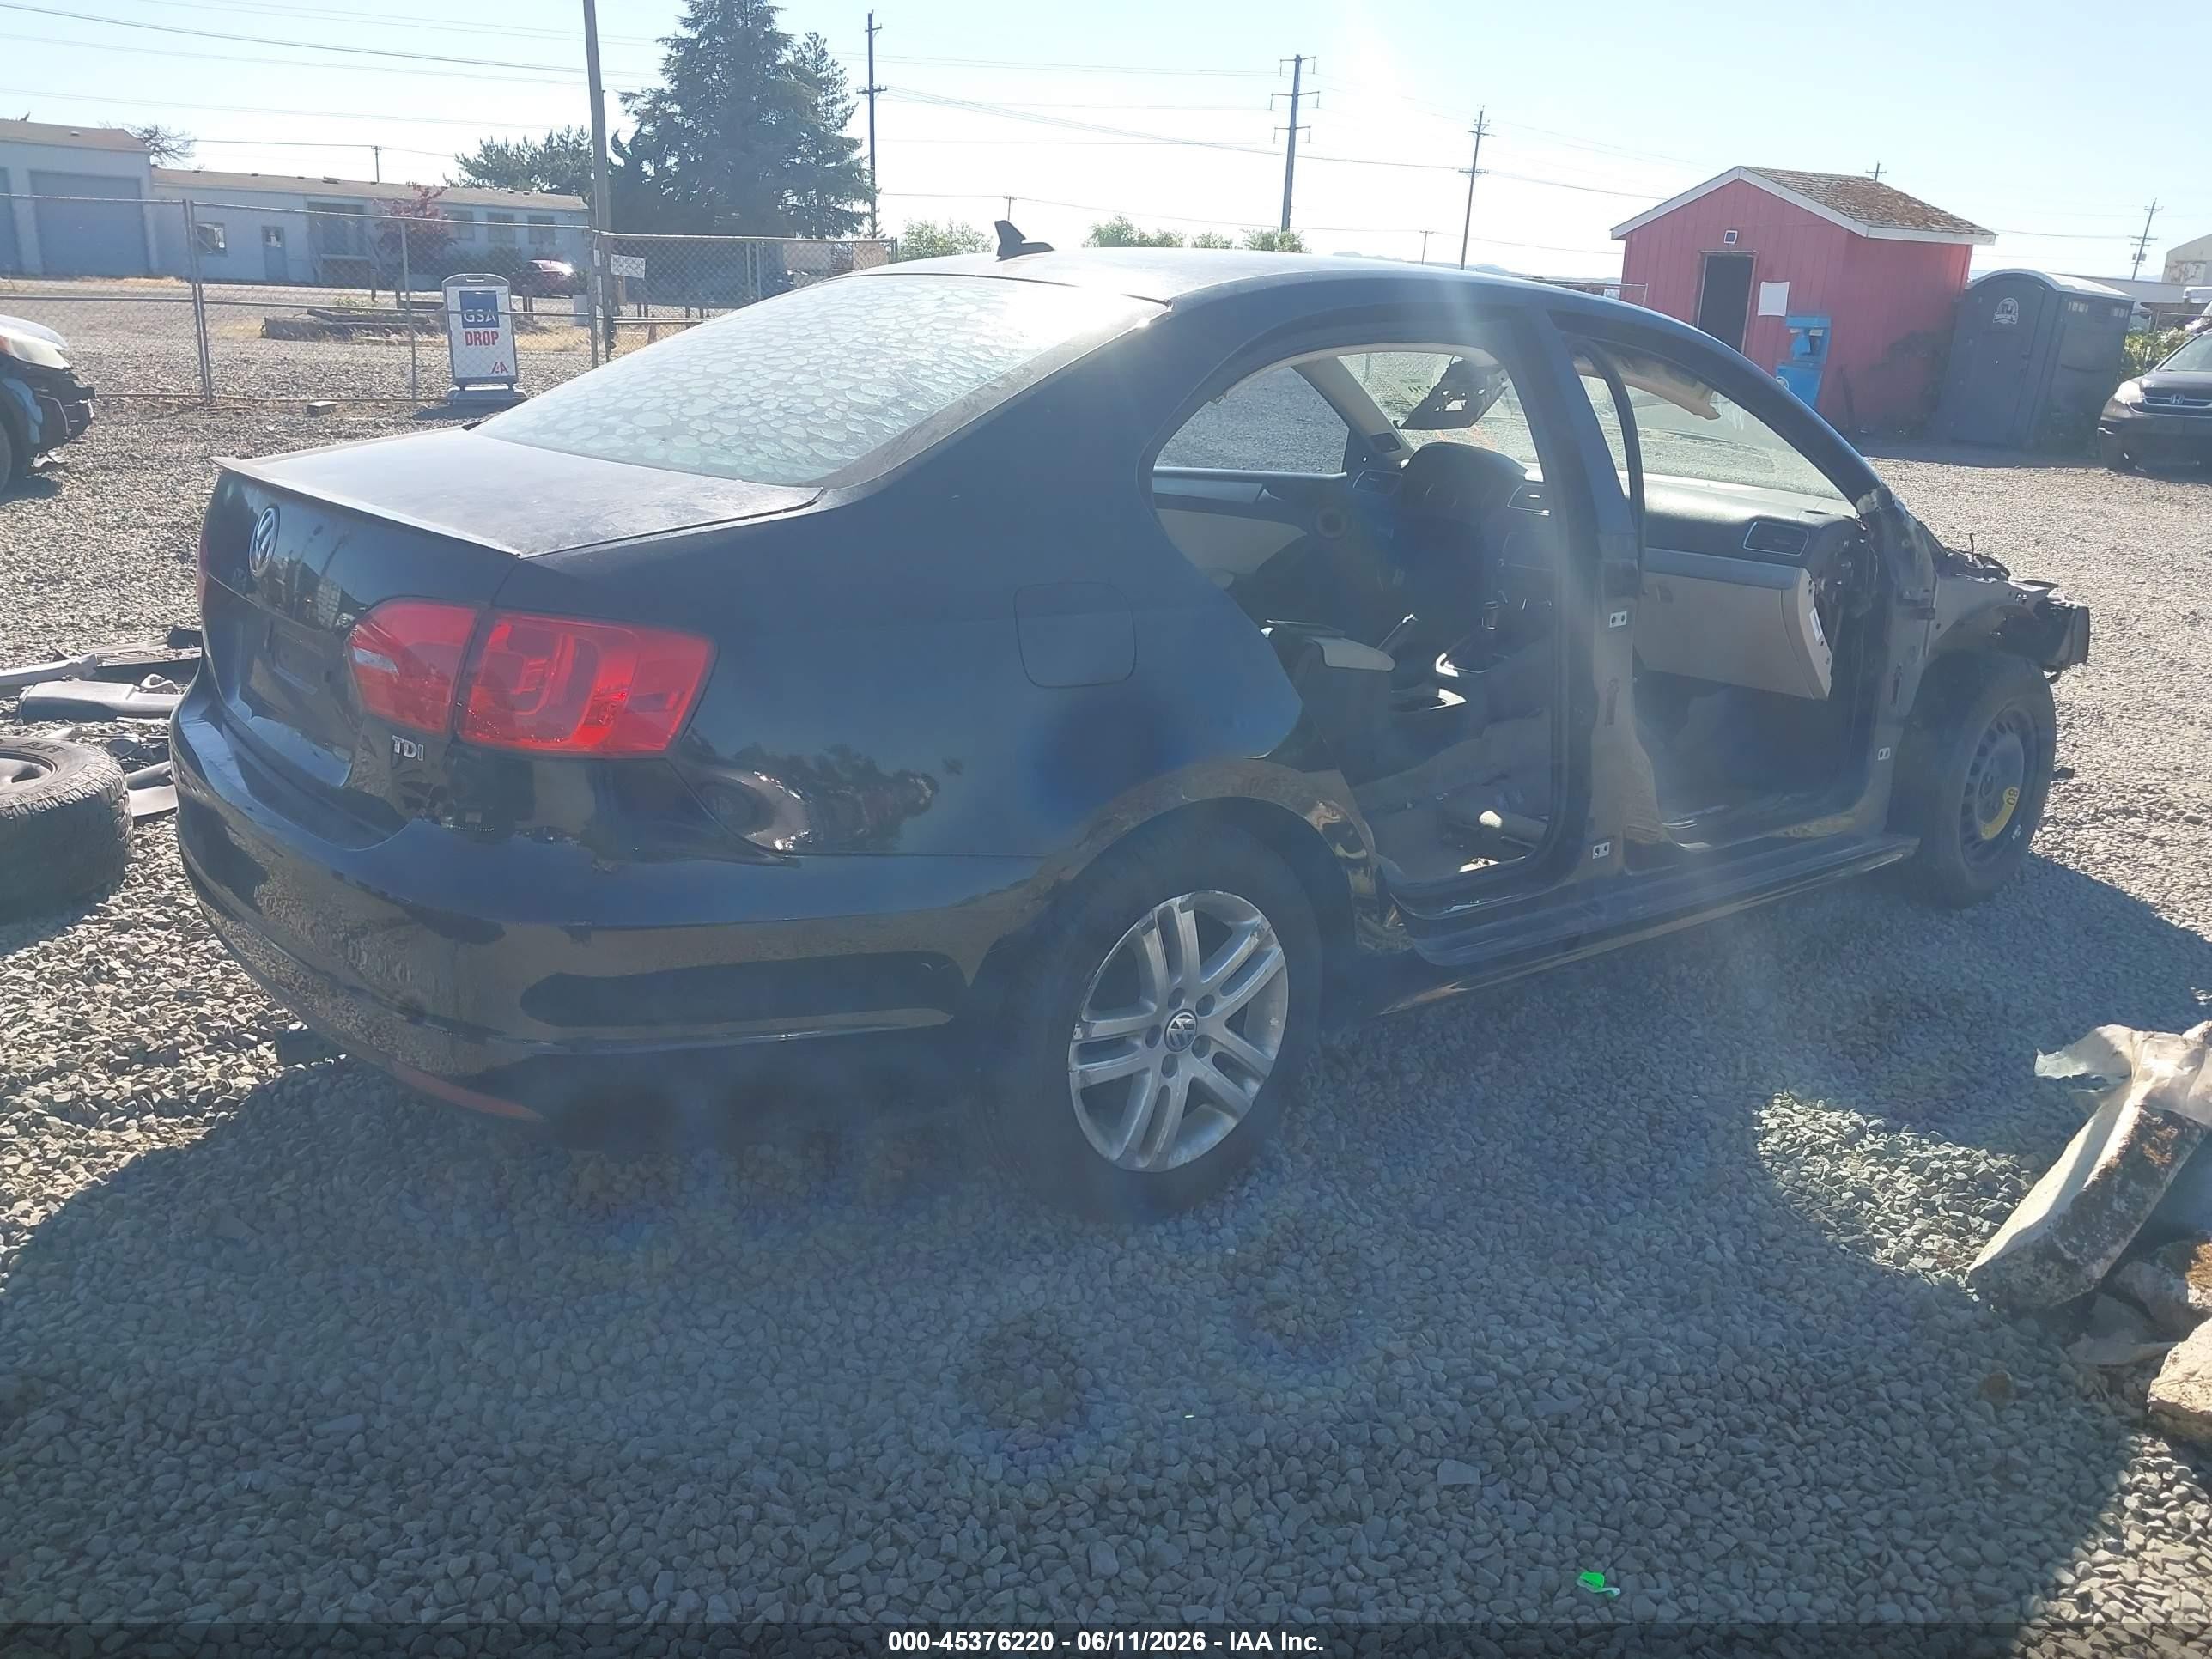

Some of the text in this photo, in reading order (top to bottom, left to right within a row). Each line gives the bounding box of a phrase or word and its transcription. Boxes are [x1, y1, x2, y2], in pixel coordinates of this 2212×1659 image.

[464, 308, 497, 324] GSA
[465, 331, 500, 346] DROP
[392, 734, 424, 762] TDI
